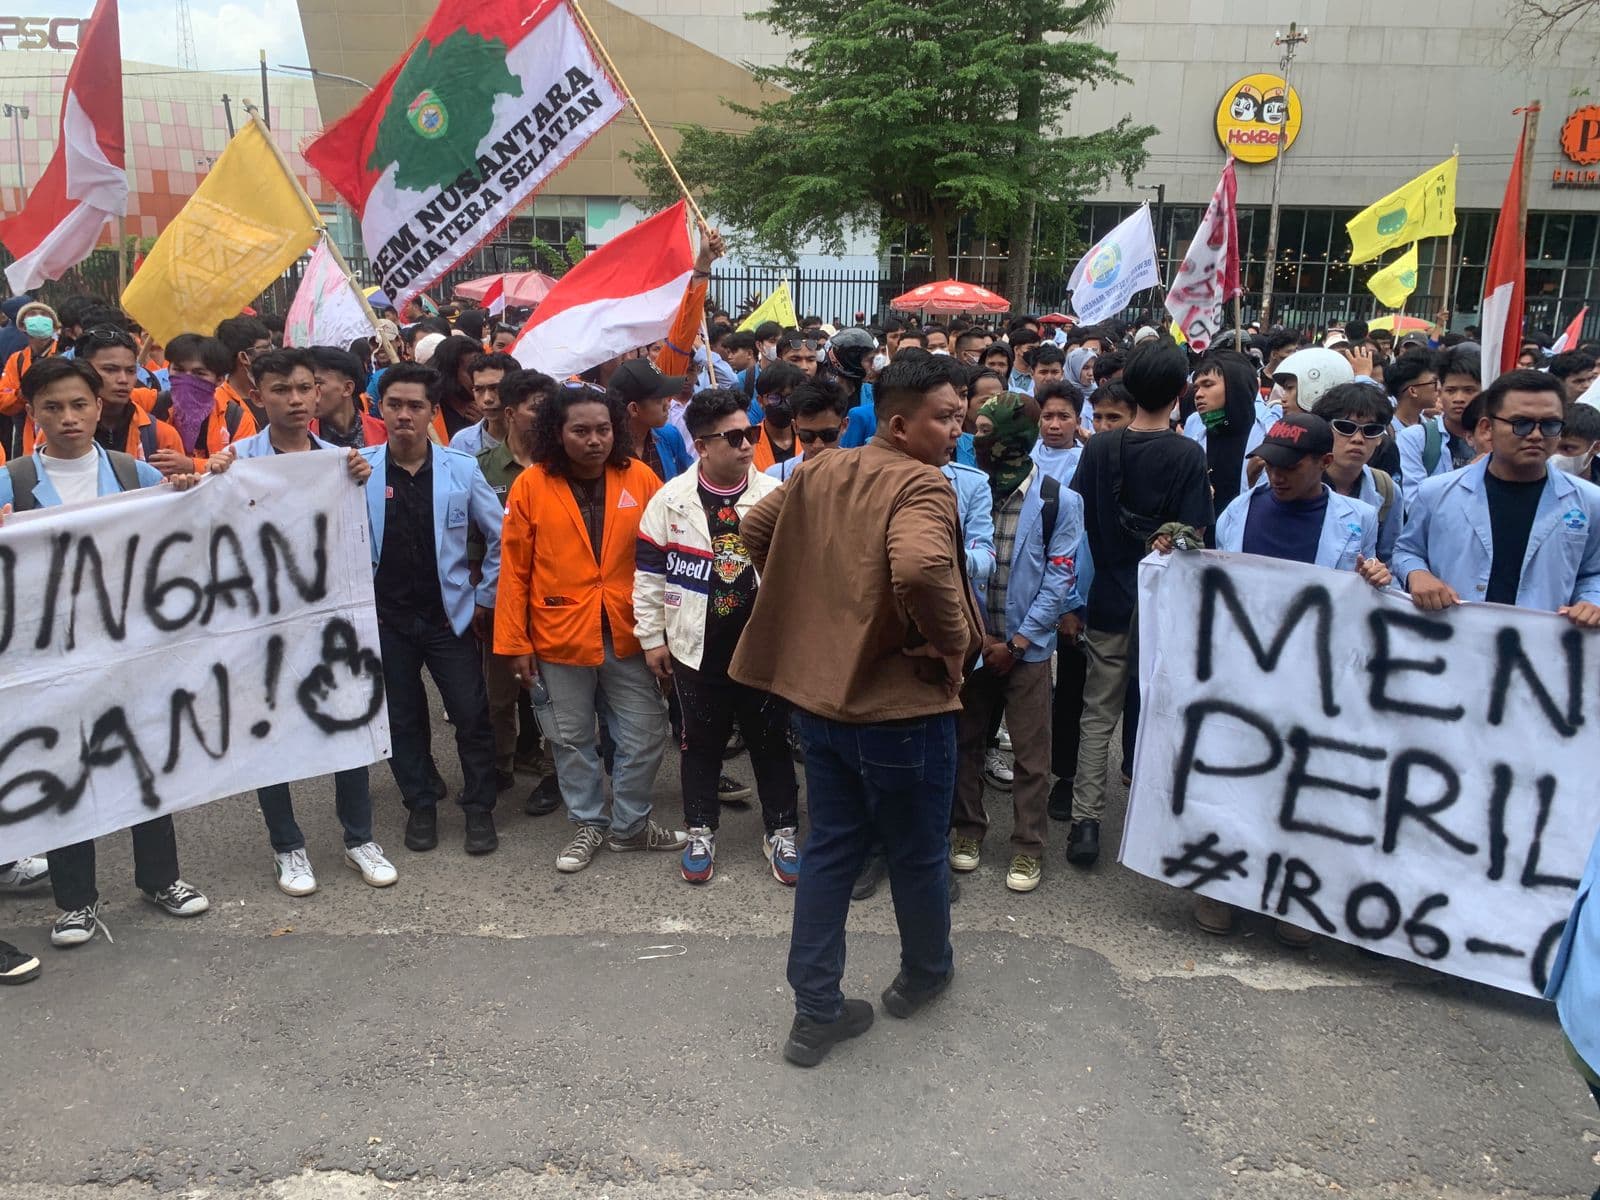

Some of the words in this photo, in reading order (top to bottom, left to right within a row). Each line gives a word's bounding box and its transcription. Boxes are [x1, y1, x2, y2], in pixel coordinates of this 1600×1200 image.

[0, 16, 90, 49] PSC
[372, 222, 419, 282] BEM
[414, 65, 595, 234] NUSANTARA
[383, 188, 503, 301] SUMATERA
[498, 88, 604, 193] SELATAN
[1552, 168, 1600, 183] PRIM
